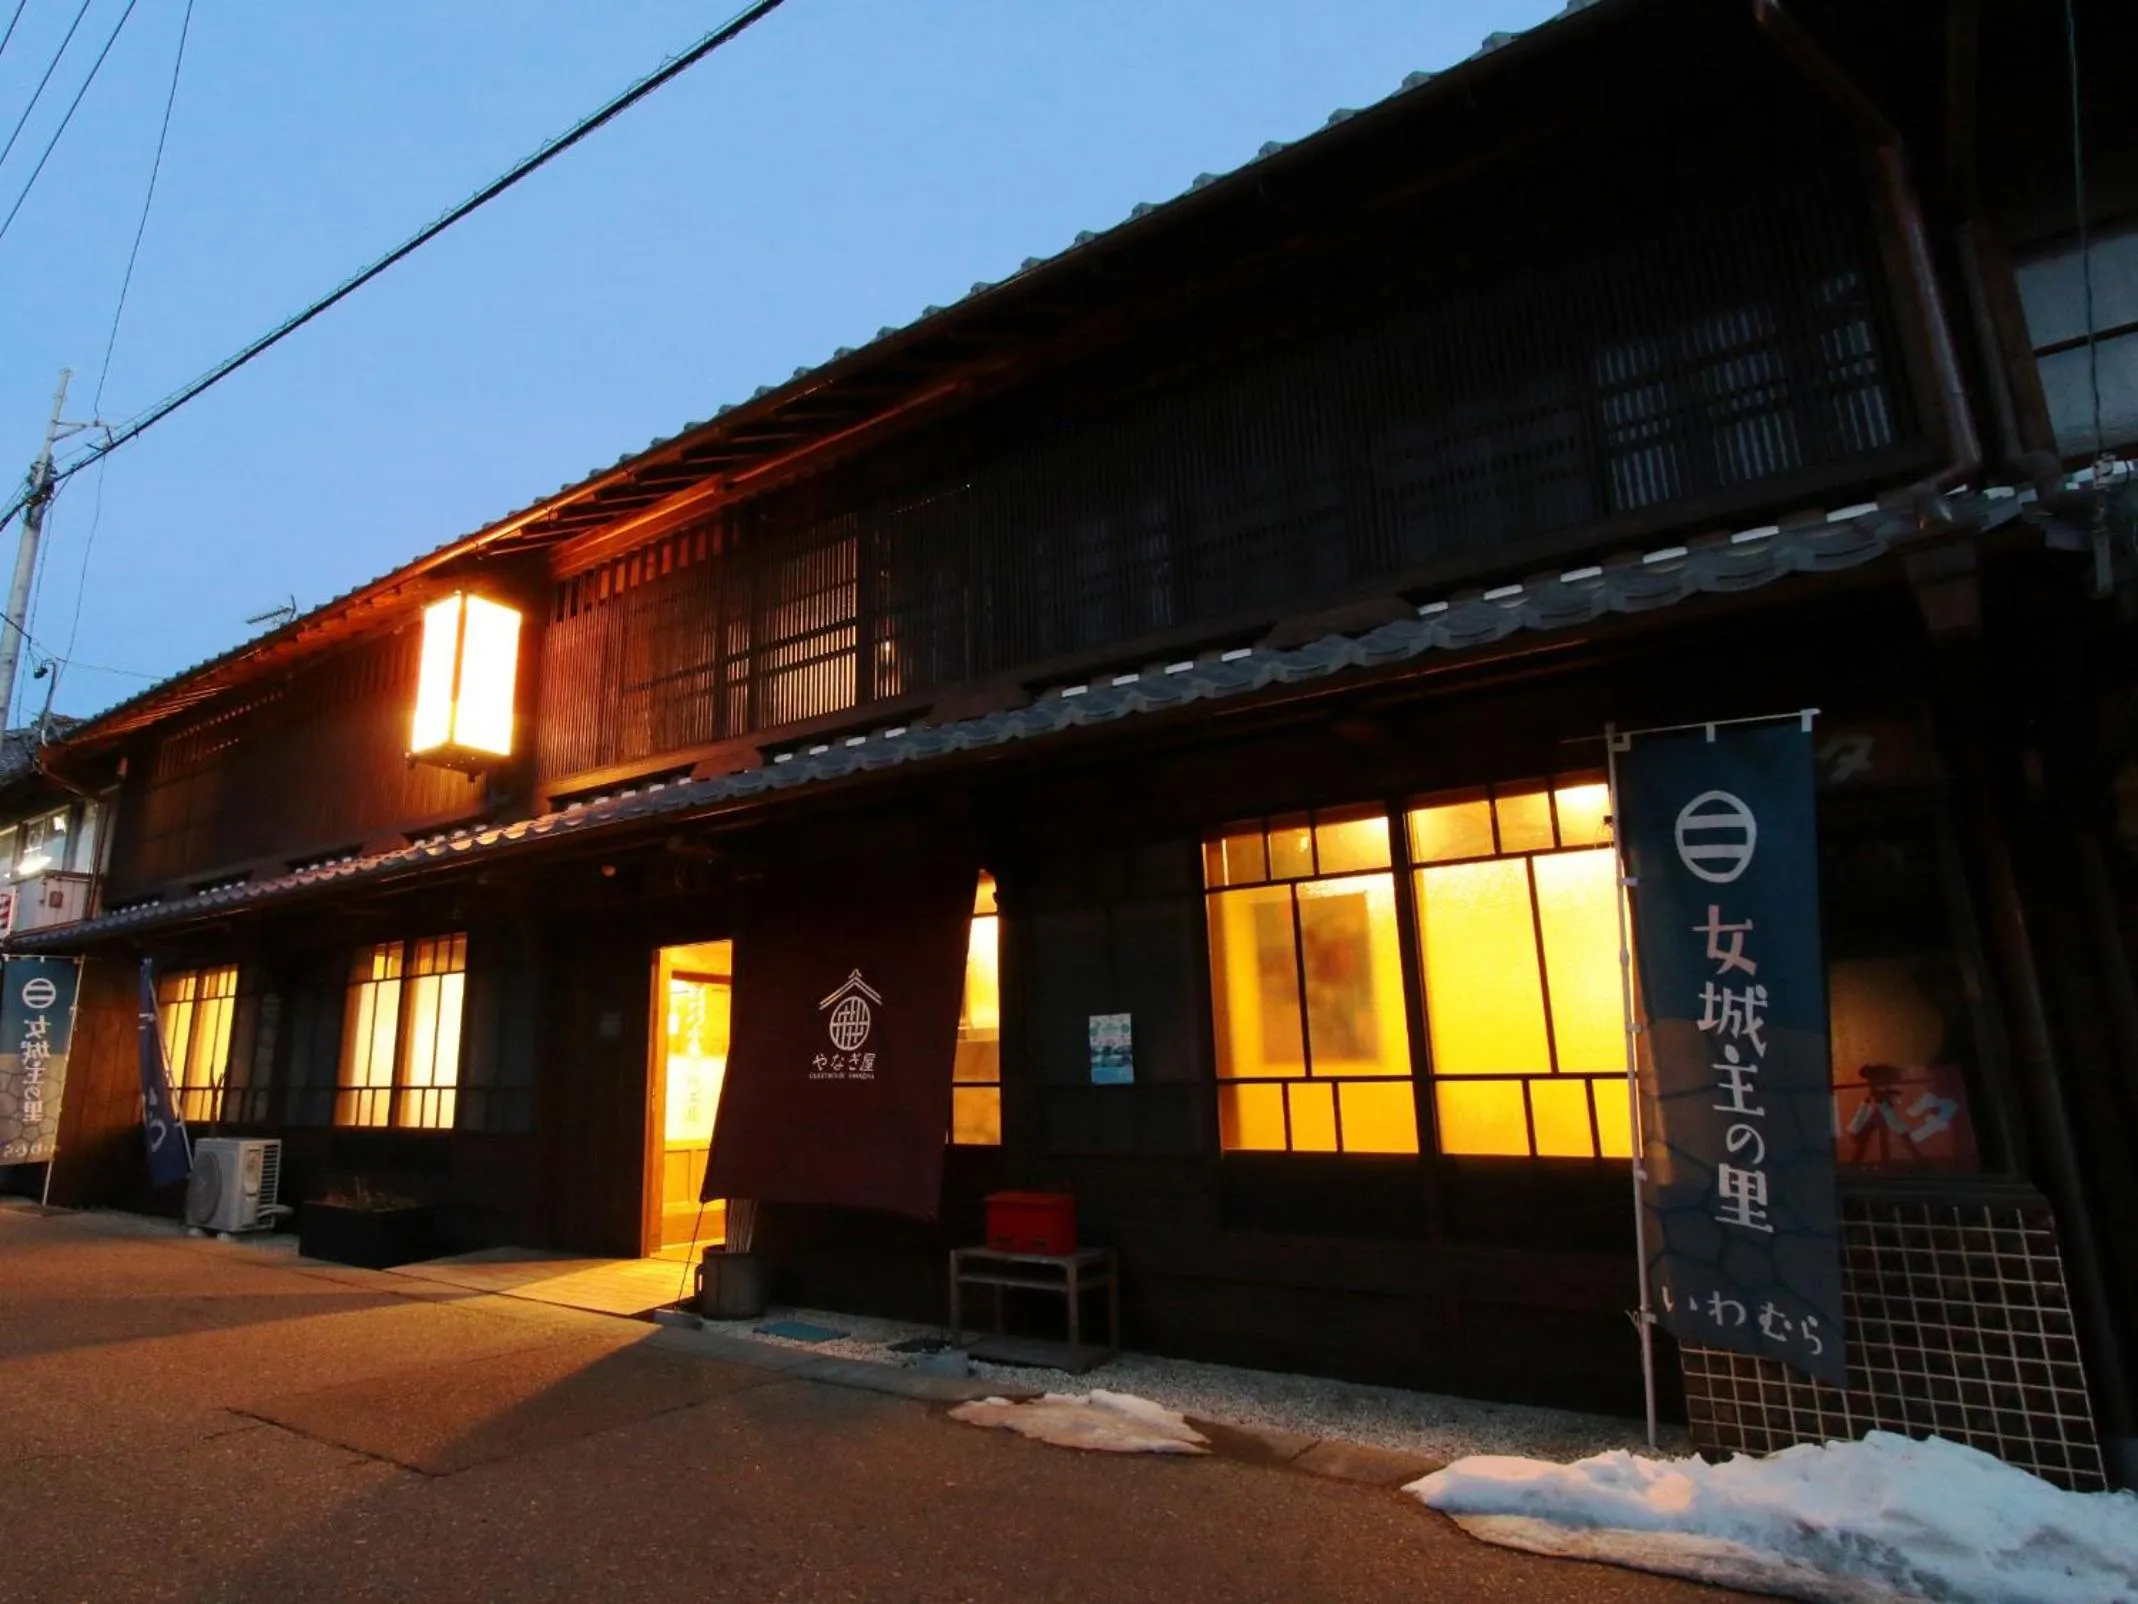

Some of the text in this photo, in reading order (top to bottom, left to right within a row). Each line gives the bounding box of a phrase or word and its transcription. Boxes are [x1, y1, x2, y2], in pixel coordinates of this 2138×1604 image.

[812, 1052, 877, 1072] やなぎ屋
[1693, 904, 1773, 1233] 女城主の里
[1662, 1286, 1823, 1355] いわむら
